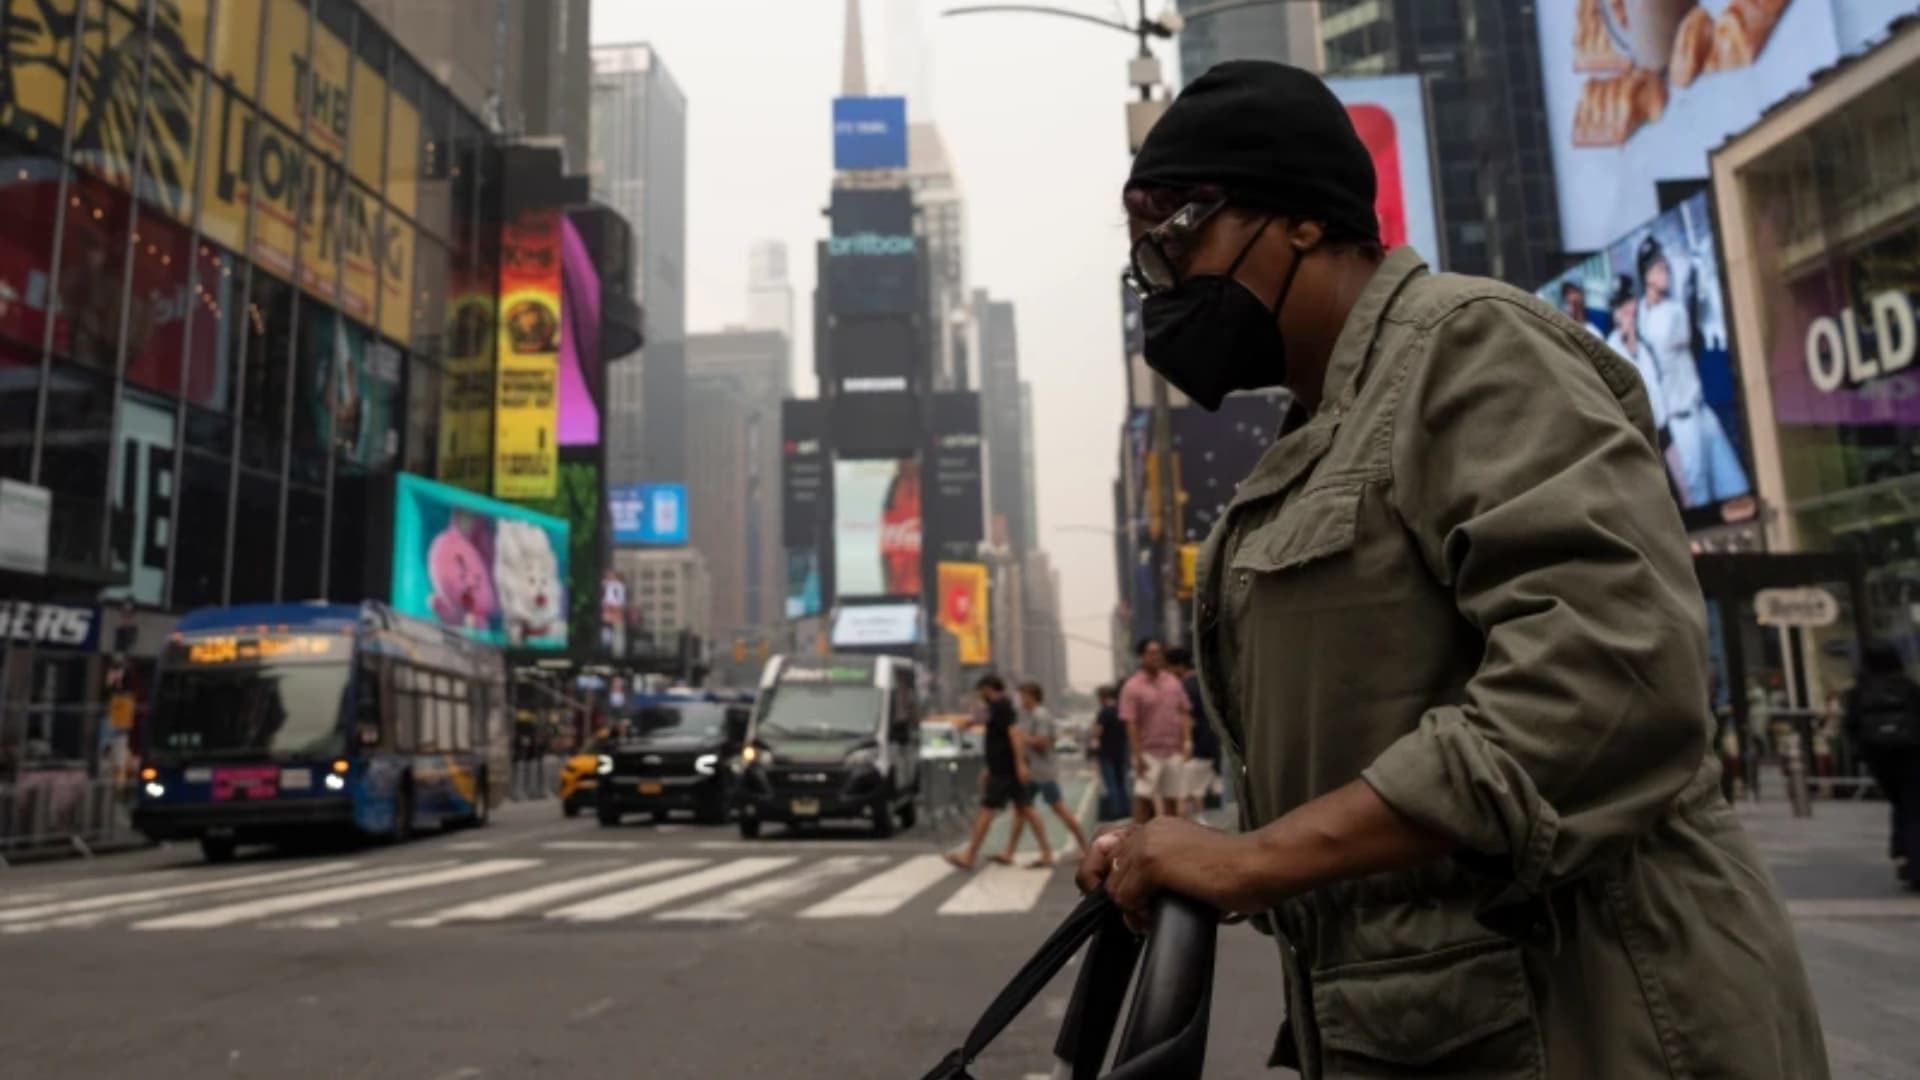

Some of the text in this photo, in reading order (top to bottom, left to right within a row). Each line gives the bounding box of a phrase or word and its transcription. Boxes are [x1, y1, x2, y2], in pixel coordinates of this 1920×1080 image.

[291, 52, 348, 138] THE
[217, 72, 316, 226] LION
[1805, 290, 1916, 393] OLD
